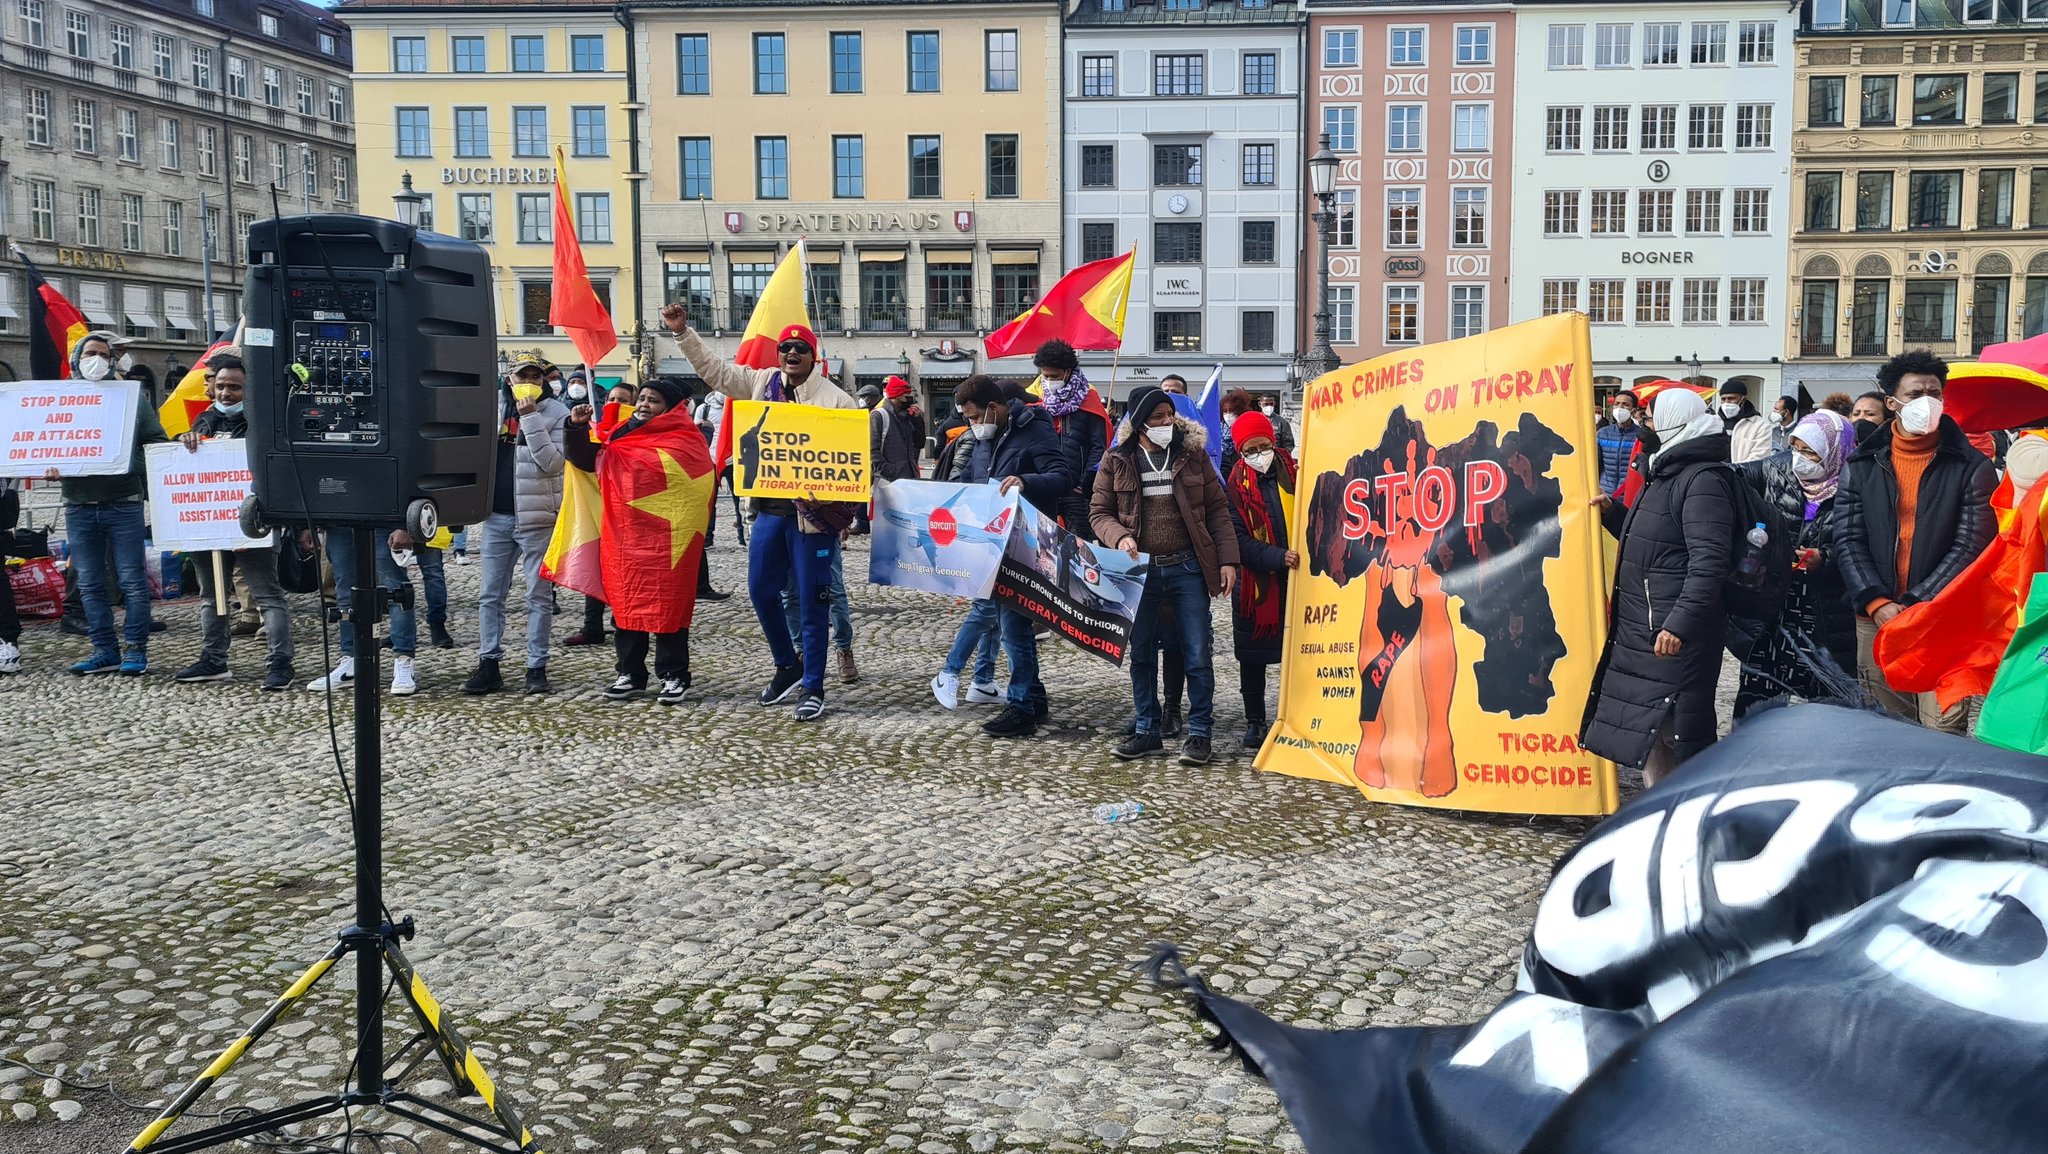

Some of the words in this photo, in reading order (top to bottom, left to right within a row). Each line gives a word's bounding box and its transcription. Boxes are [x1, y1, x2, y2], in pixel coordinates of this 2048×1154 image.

[757, 213, 940, 231] SPATENHAUS
[58, 248, 128, 271] PRADA
[1621, 251, 1693, 263] BOGNER
[1389, 259, 1418, 273] gössl
[1167, 279, 1189, 289] IWC
[1133, 368, 1150, 376] IWC
[1310, 381, 1343, 412] WAR
[1352, 359, 1424, 399] CRIMES
[1424, 384, 1459, 415] ON
[1471, 363, 1574, 406] TIGRAY
[21, 395, 55, 408] STOP
[58, 394, 103, 406] DRONE
[45, 412, 73, 424] AND
[12, 431, 35, 442] AIR
[38, 429, 102, 442] ATTACKS
[760, 431, 810, 446] STOP
[9, 448, 27, 460] ON
[31, 446, 103, 459] CIVILIANS!
[760, 448, 862, 465] GENOCIDE
[163, 473, 195, 486] ALLOW
[197, 470, 255, 484] UNIMPEDED
[761, 464, 780, 479] IN
[791, 466, 863, 482] TIGRAY
[759, 479, 802, 490] TIGRAY
[803, 482, 833, 492] can't
[835, 483, 861, 493] wait
[171, 489, 244, 504] HUMANITARIAN
[1342, 460, 1508, 540] STOP
[929, 520, 956, 530] BOYCOTT
[896, 559, 912, 572] Stop
[912, 562, 934, 575] Tigray
[935, 565, 971, 578] Genocide
[1001, 565, 1030, 585] TURKEY
[1030, 580, 1053, 601] DRONE
[1053, 596, 1072, 615] SALES
[1072, 609, 1083, 621] TO
[1084, 616, 1124, 637] ETHIOPIA
[1304, 603, 1338, 626] RAPE
[1017, 593, 1059, 624] TIGRAY
[1060, 620, 1121, 659] GENOCIDE
[1300, 643, 1325, 655] SEXUAL
[1328, 642, 1355, 653] ABUSE
[1370, 630, 1406, 689] RAPE
[1316, 666, 1355, 679] AGAINST
[1322, 686, 1356, 699] WOMEN
[1310, 718, 1322, 730] BY
[1498, 732, 1585, 755] TIGRA
[1463, 763, 1592, 788] GENOCIDE
